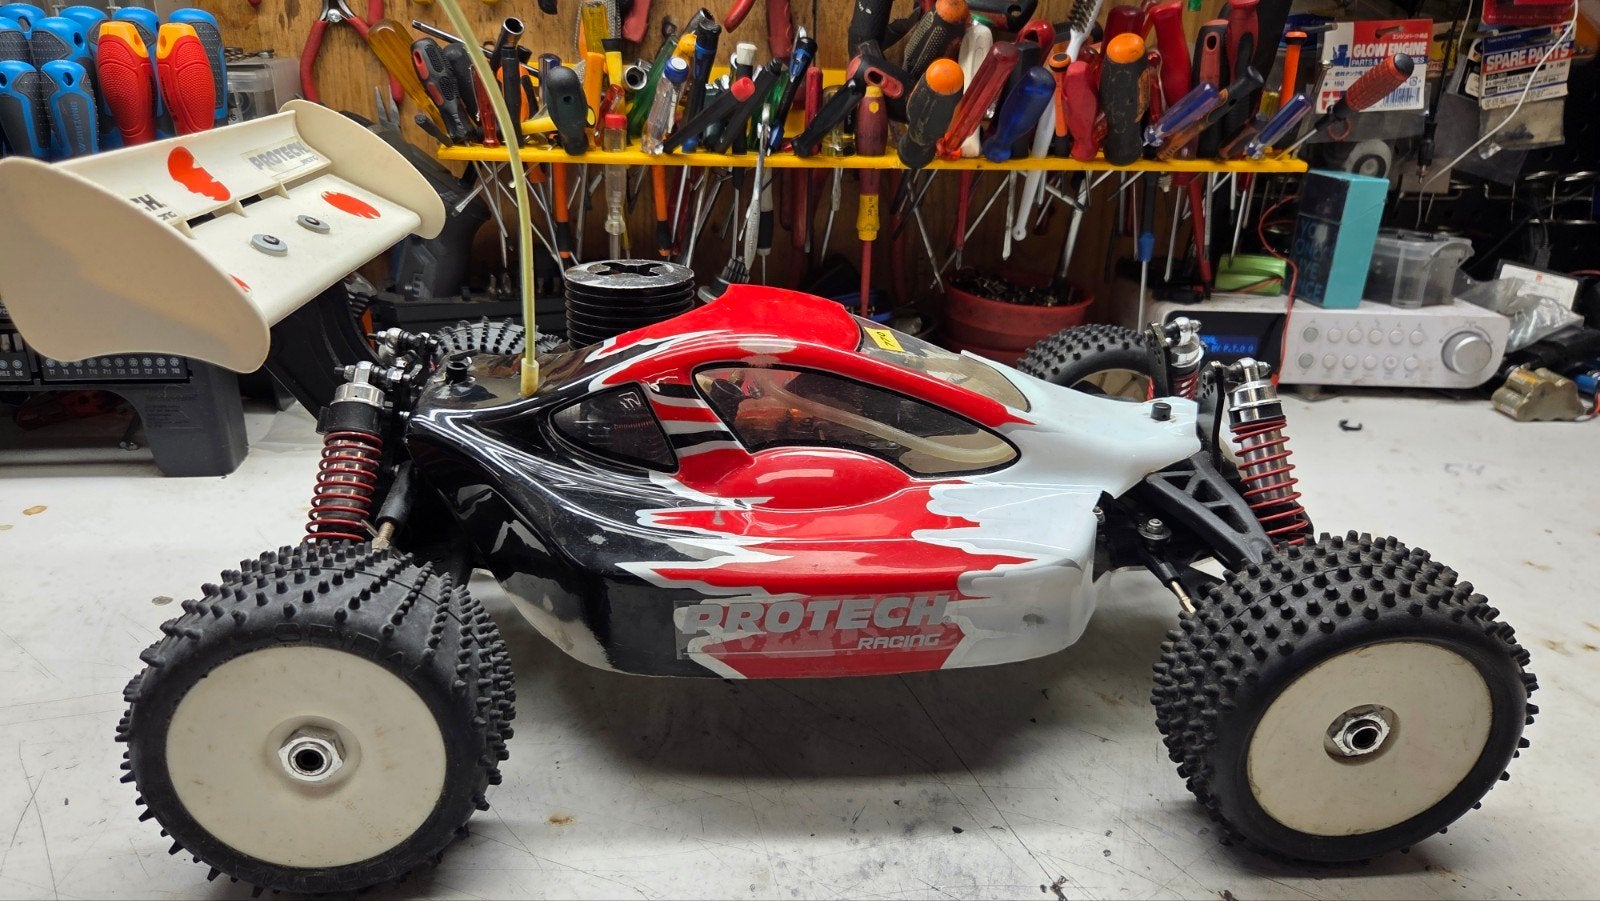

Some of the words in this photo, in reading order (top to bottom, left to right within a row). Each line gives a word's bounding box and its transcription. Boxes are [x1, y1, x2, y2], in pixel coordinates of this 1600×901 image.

[1353, 43, 1388, 58] GLOW
[1388, 41, 1428, 56] ENGINE
[1486, 50, 1527, 71] SPARE
[1528, 42, 1570, 64] PARTS
[1351, 58, 1373, 67] PARTS
[248, 141, 311, 170] PROTECH
[682, 596, 949, 634] PROTECH
[857, 634, 941, 650] RACING
